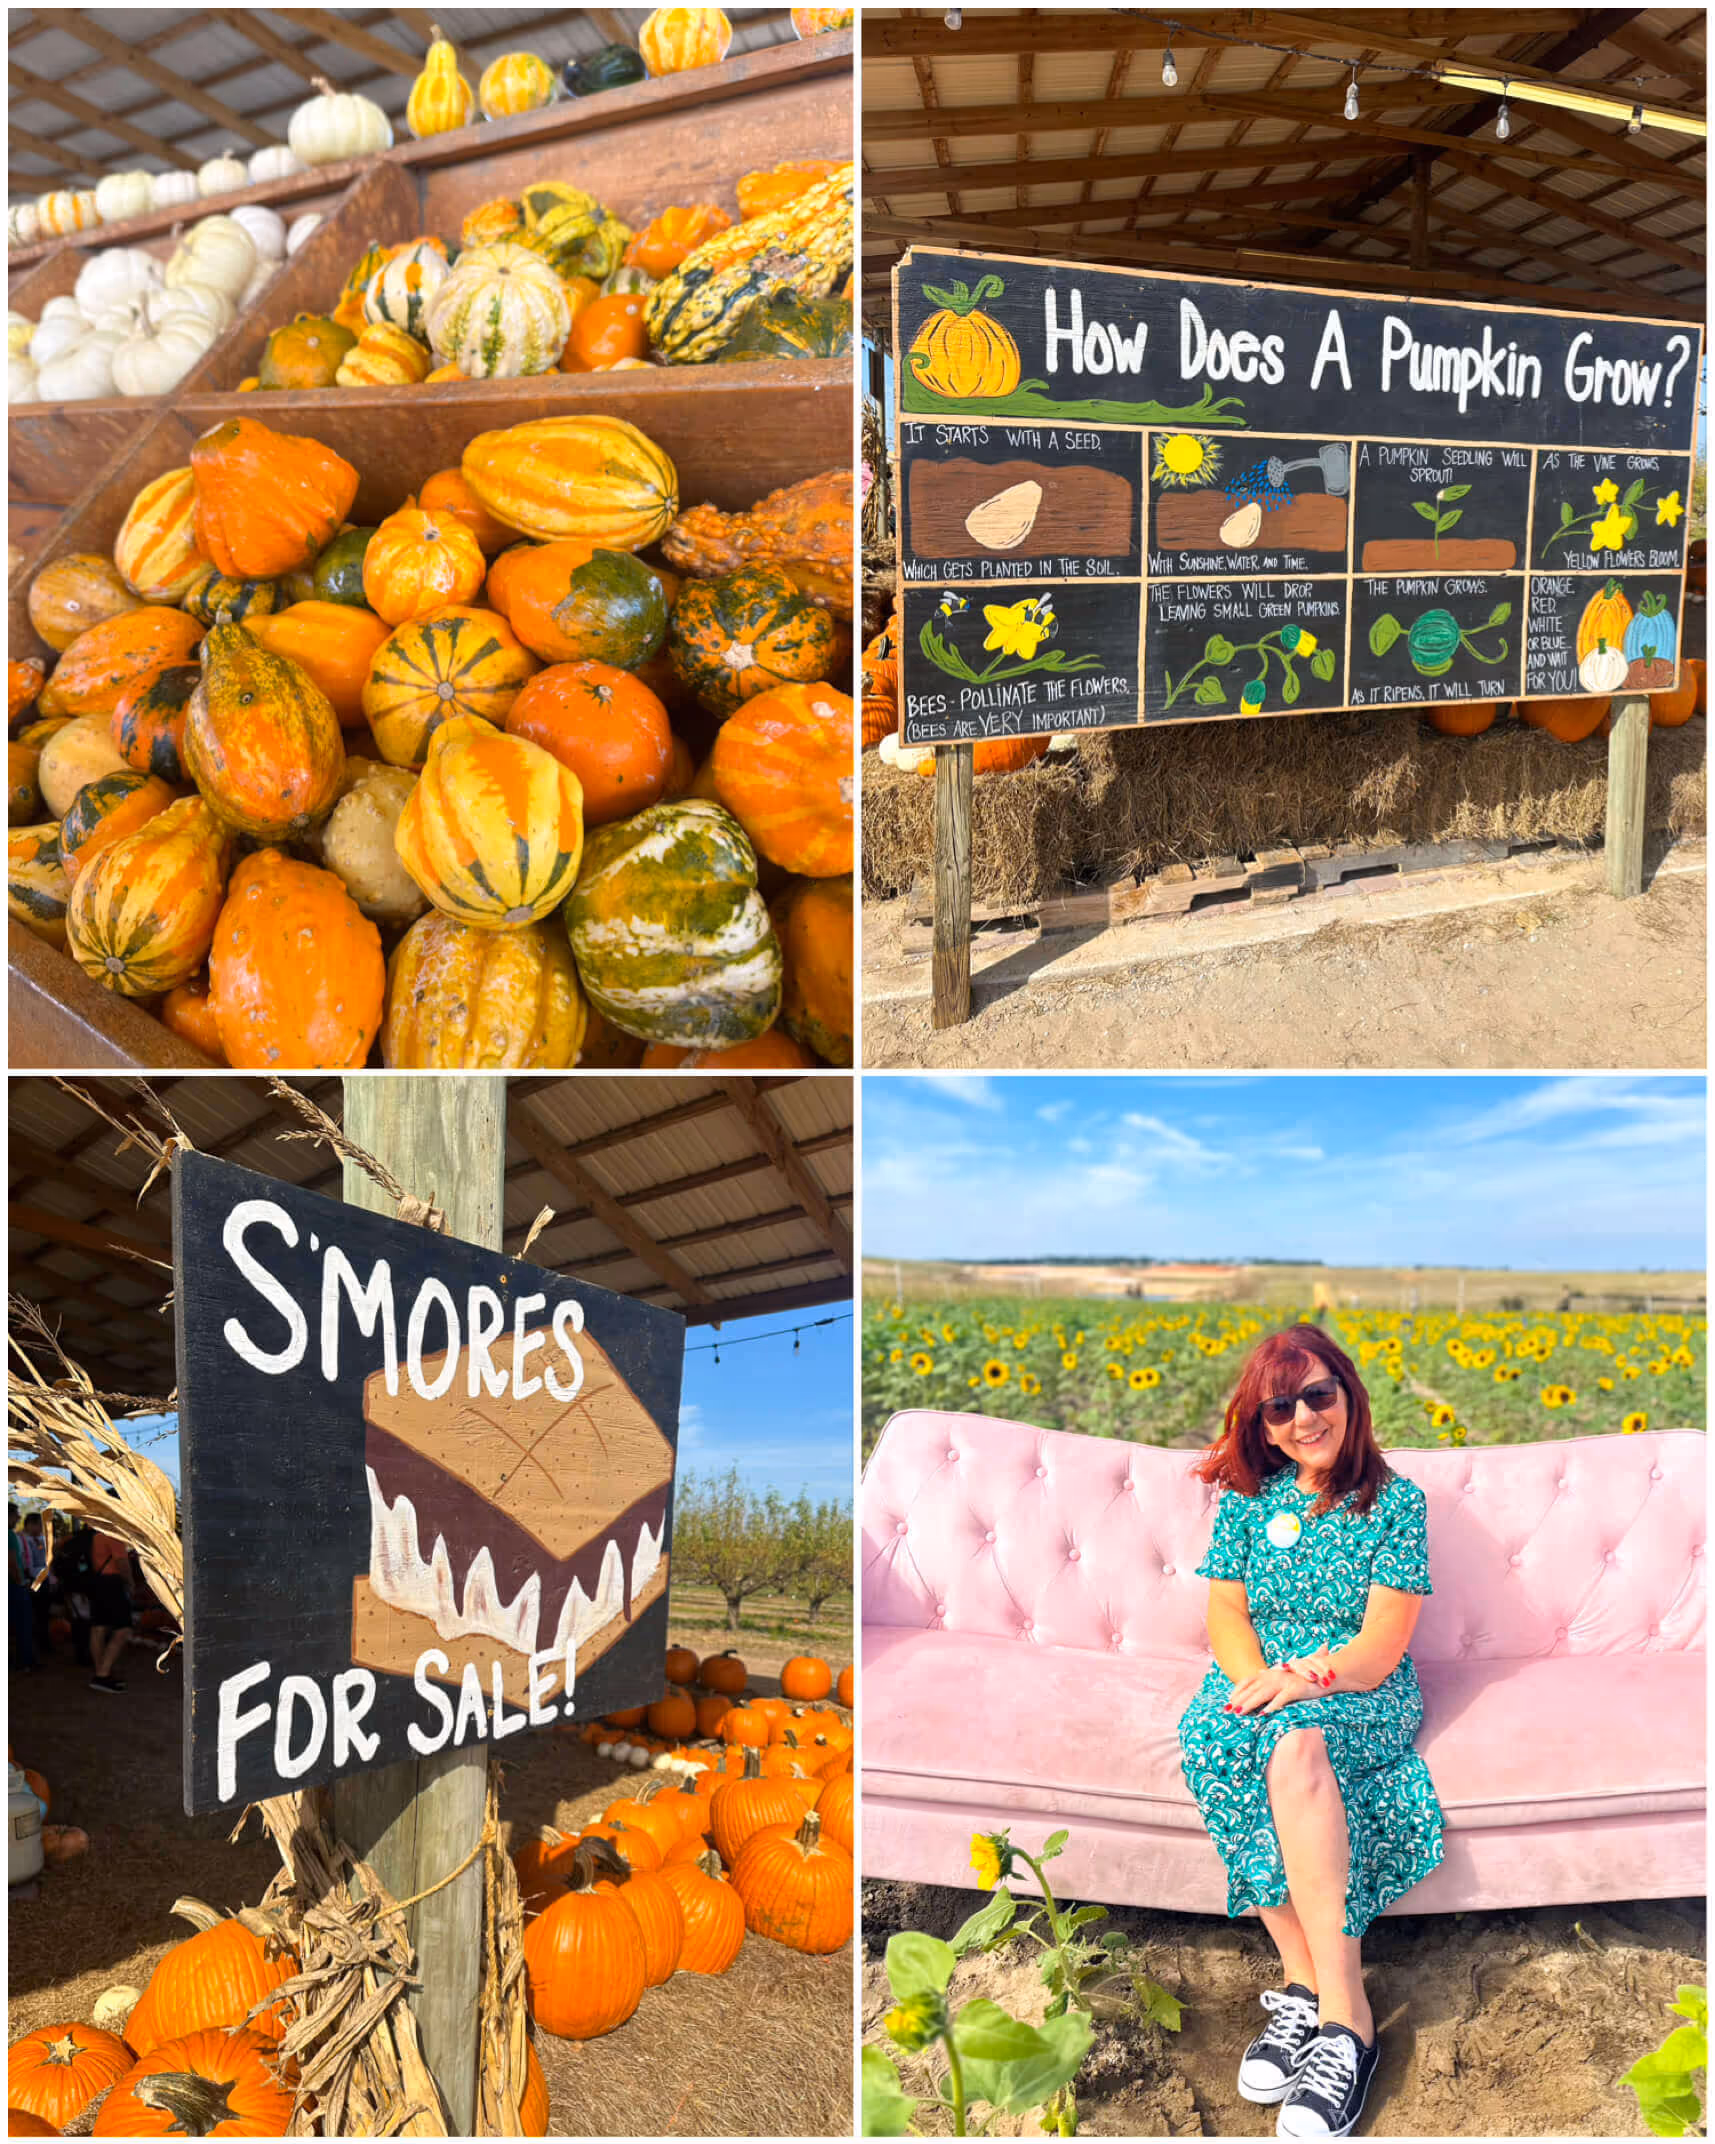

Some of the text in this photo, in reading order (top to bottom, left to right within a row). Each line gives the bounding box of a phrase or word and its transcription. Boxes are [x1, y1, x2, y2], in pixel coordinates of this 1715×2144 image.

[1045, 288, 1690, 413] How Does A Pumpkin Grow?
[905, 423, 924, 444] IT
[936, 425, 989, 446] STARTS
[1006, 429, 1040, 449] WITH
[1049, 430, 1059, 450] A
[1359, 443, 1528, 468] A PUMPKIN SEEDLING WILL
[1543, 452, 1560, 470] AS
[1568, 453, 1585, 470] THE
[1594, 455, 1616, 472] VINE
[903, 559, 1120, 581] WHICH GETS PLANTED IN THE SOIL.
[1148, 552, 1172, 575] WITH
[1262, 557, 1278, 568] AND
[1563, 550, 1600, 569] YELLOW
[1604, 549, 1645, 568] FLOWERS
[1149, 584, 1170, 602] THE
[1178, 584, 1231, 600] FLOWERS
[1241, 584, 1274, 600] WILL
[1363, 579, 1388, 596] THE
[1396, 578, 1439, 596] PUMPKIN
[1160, 603, 1206, 622] LEAVING
[1214, 603, 1253, 621] SMALL
[1259, 603, 1292, 618] GREEN
[1528, 639, 1541, 650] OR
[1527, 656, 1568, 670] AND WAIT
[1527, 667, 1577, 693] FOR YOU!
[907, 694, 946, 718] BEES
[960, 681, 1037, 710] POLLINATE
[1043, 679, 1065, 700] THE
[1351, 688, 1364, 704] AS
[1369, 688, 1380, 703] IT
[1429, 683, 1440, 699] IT
[1445, 680, 1472, 697] WILL
[1477, 680, 1505, 696] TURN
[906, 705, 1105, 744] (BEES ARE VERY IMPORTANT)
[222, 1199, 586, 1402] S'MORES
[216, 1638, 577, 1803] FOR SALE!
